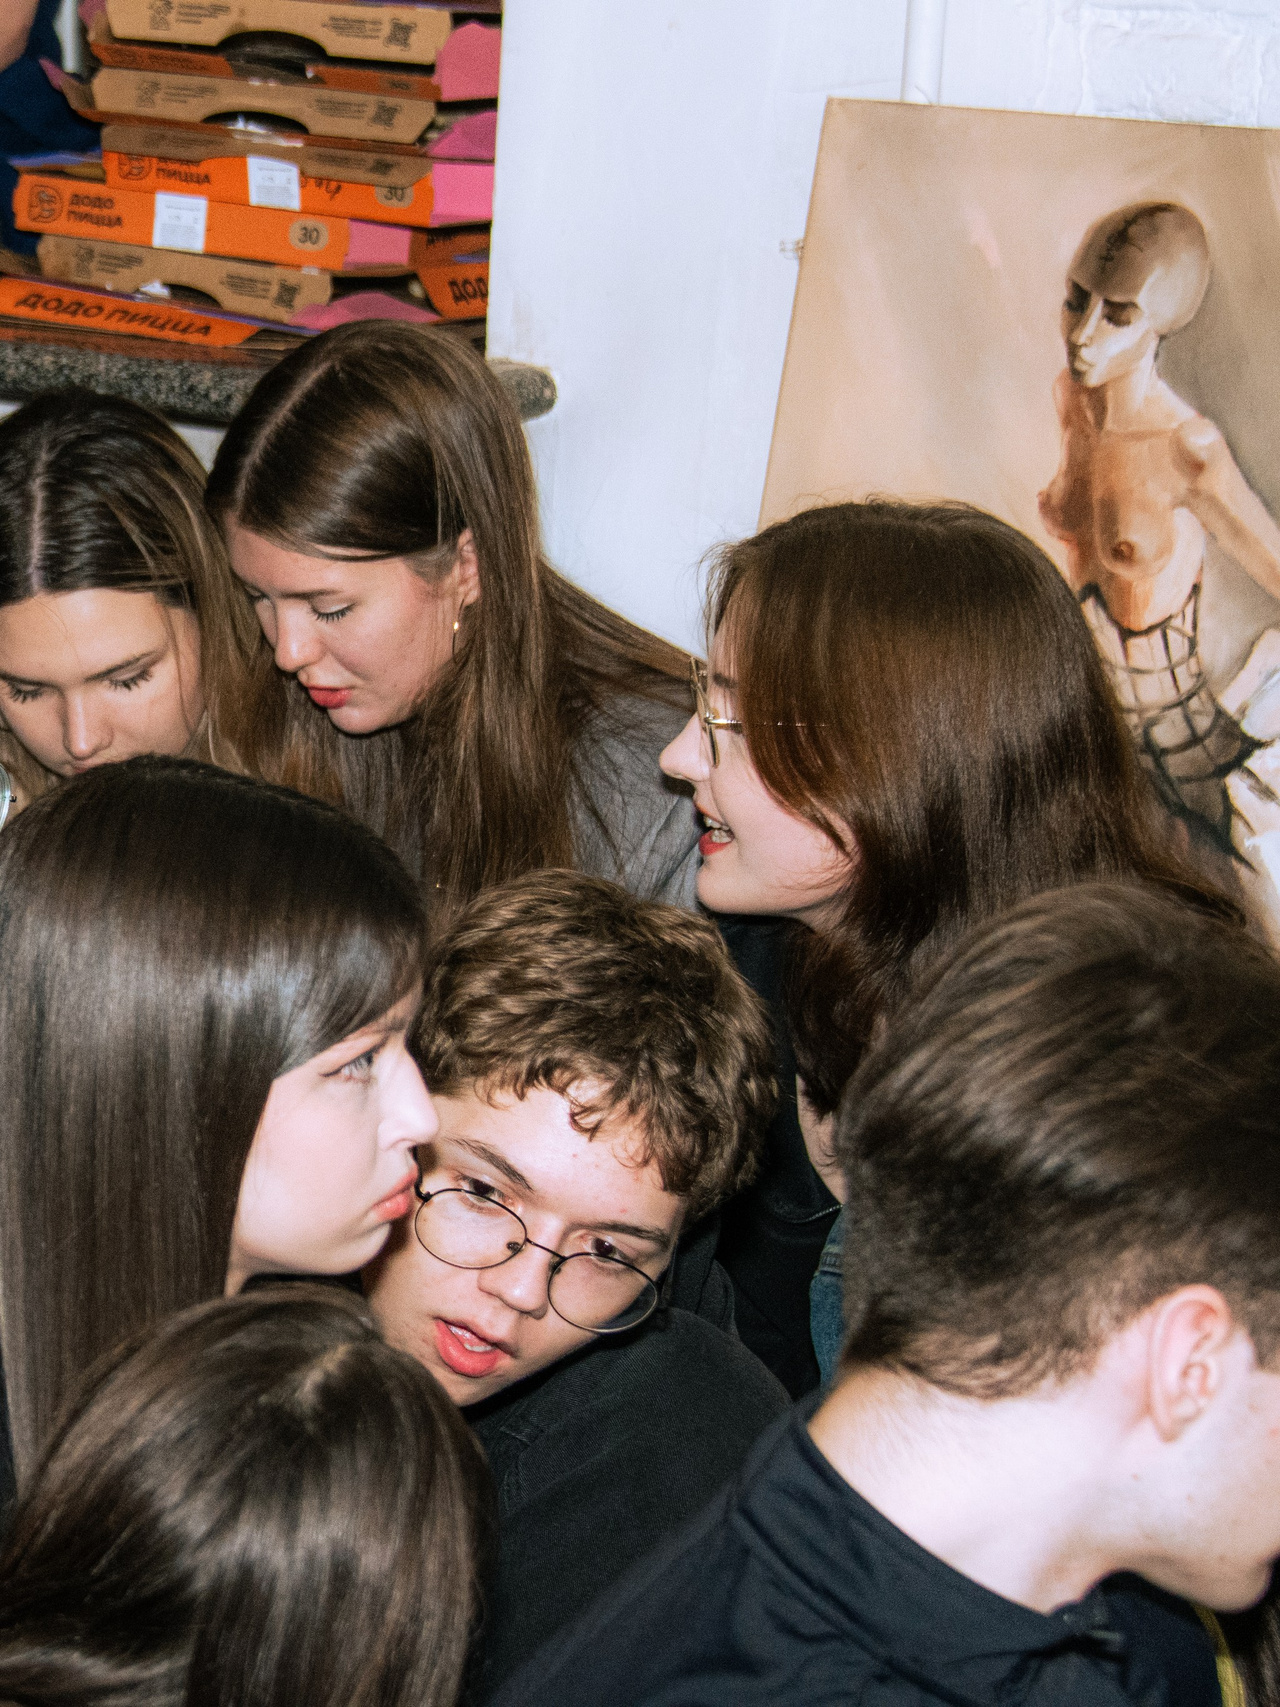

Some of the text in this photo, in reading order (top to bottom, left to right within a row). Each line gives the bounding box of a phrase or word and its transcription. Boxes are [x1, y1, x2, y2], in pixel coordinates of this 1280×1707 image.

[156, 167, 211, 185] ПИЦЦА
[70, 193, 115, 210] ДОДО
[67, 209, 123, 228] ПИЦЦА
[297, 225, 320, 246] 30
[448, 277, 488, 305] ДОД
[15, 292, 212, 337] ДОДО ПИЦЦА
